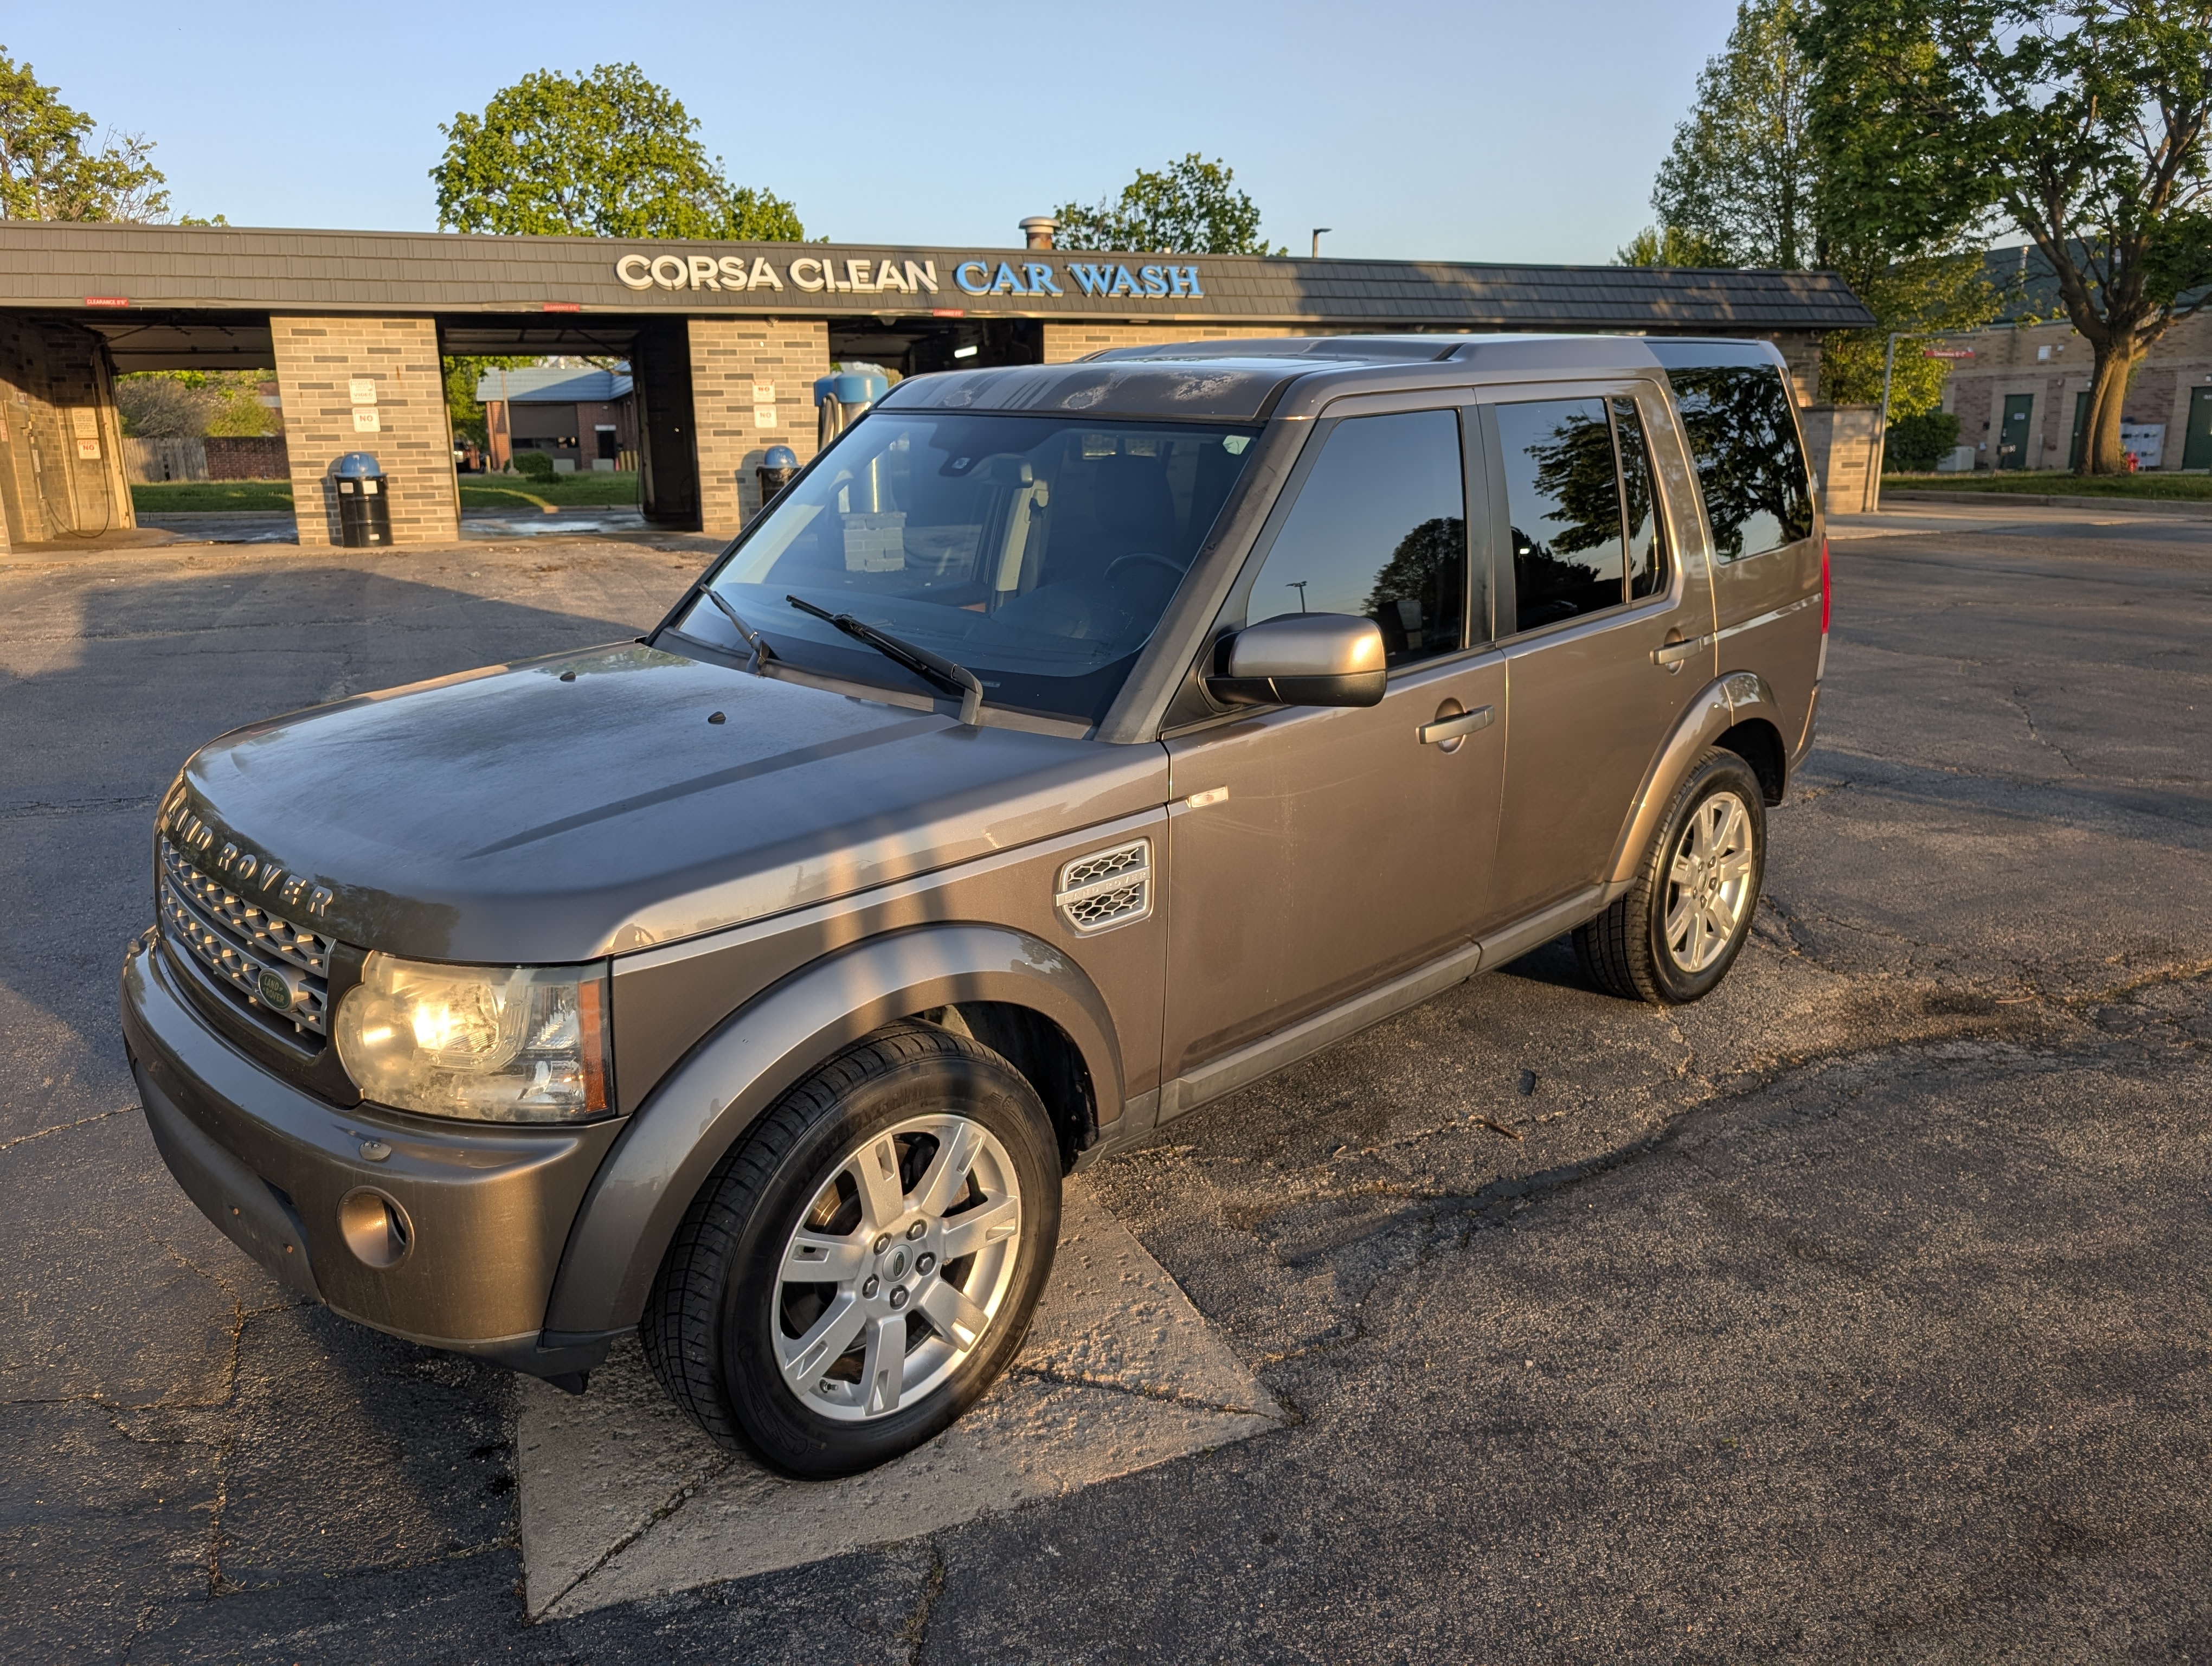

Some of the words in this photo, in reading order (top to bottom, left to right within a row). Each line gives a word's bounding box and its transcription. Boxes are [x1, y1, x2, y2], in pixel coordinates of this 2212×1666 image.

[616, 254, 783, 292] CORSA
[789, 258, 939, 294] CLEAN
[954, 261, 1064, 297] CAR
[1066, 264, 1204, 299] WASH
[165, 797, 213, 851] LAND
[217, 842, 335, 917] ROVER
[1064, 886, 1099, 902] LAND
[1105, 871, 1146, 890] ROVER
[264, 976, 280, 991] LAND
[266, 987, 285, 1004] ROVER
